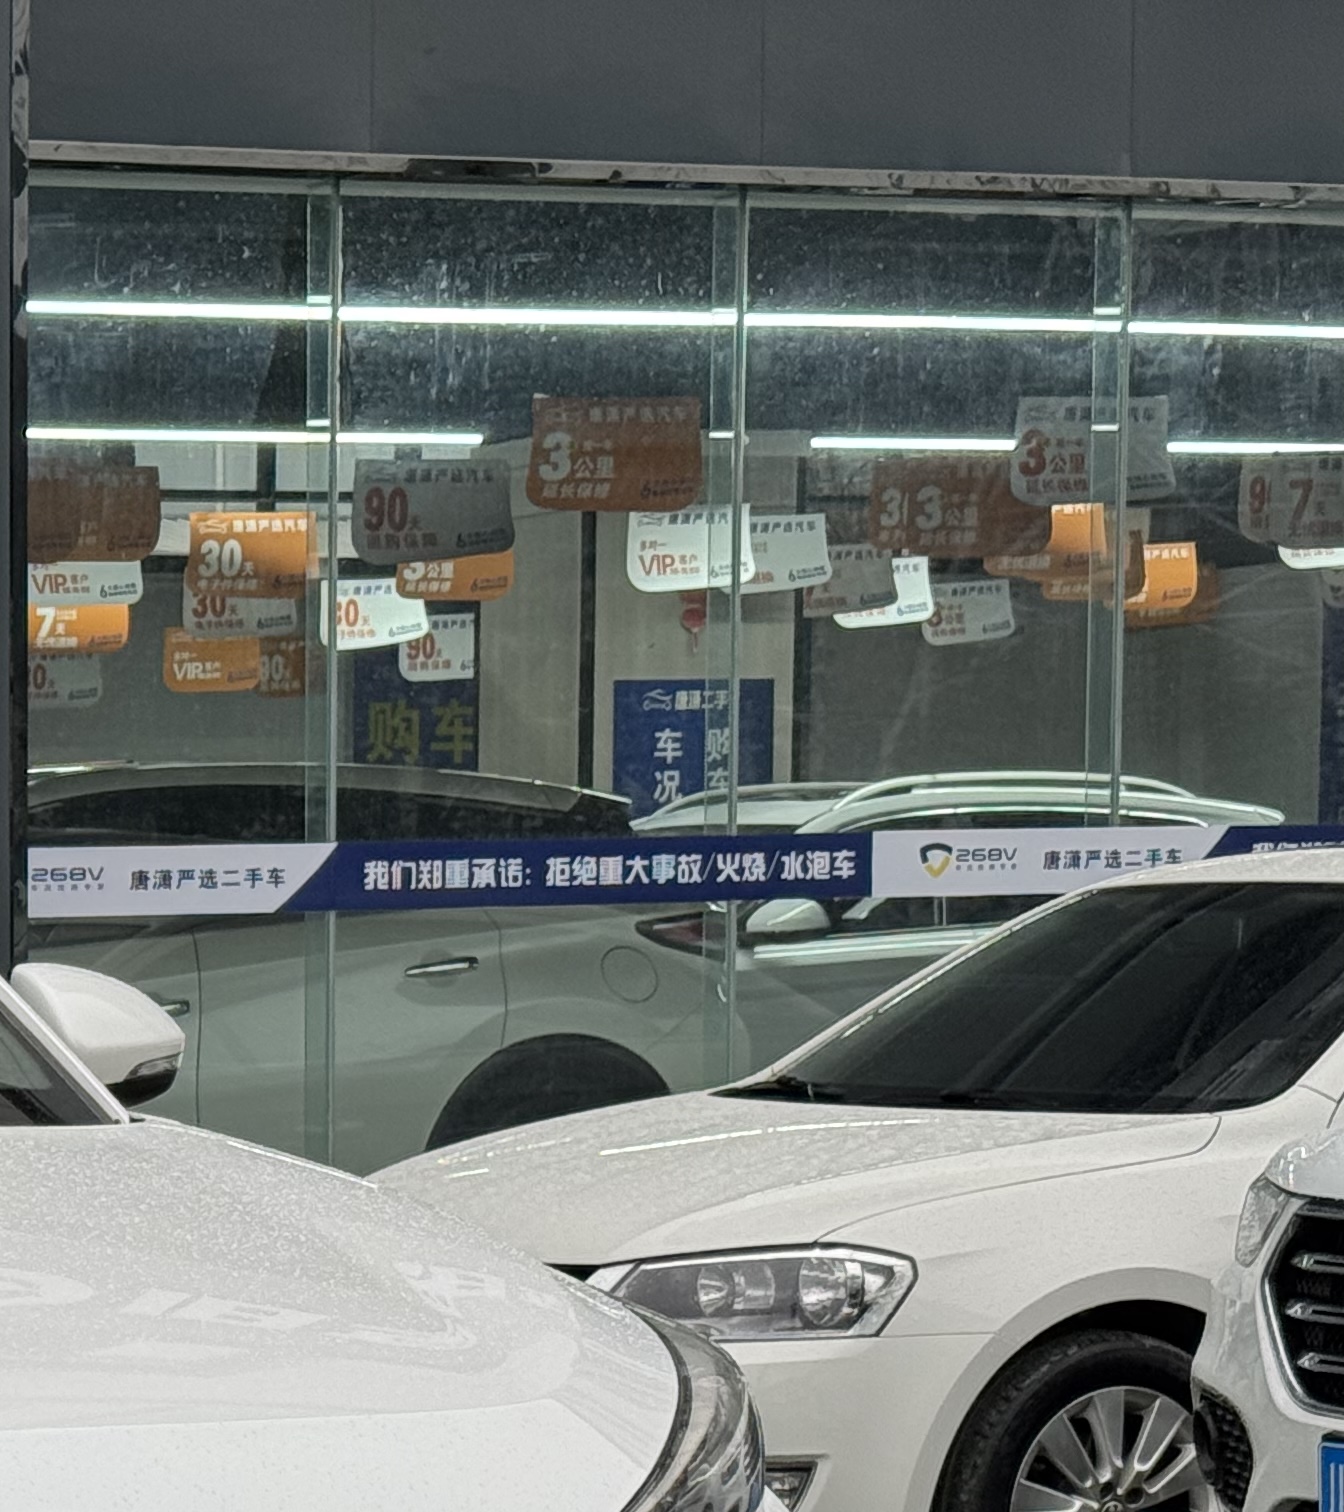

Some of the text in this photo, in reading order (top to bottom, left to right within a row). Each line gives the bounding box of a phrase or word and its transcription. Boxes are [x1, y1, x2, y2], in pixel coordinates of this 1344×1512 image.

[539, 431, 572, 481] 3
[639, 555, 676, 576] VIP
[32, 574, 67, 595] VIP
[366, 698, 474, 764] 购车
[955, 847, 1183, 871] 268V 唐潇严选二手车
[31, 866, 104, 883] 268V
[129, 867, 286, 891] 唐潇严选二手车
